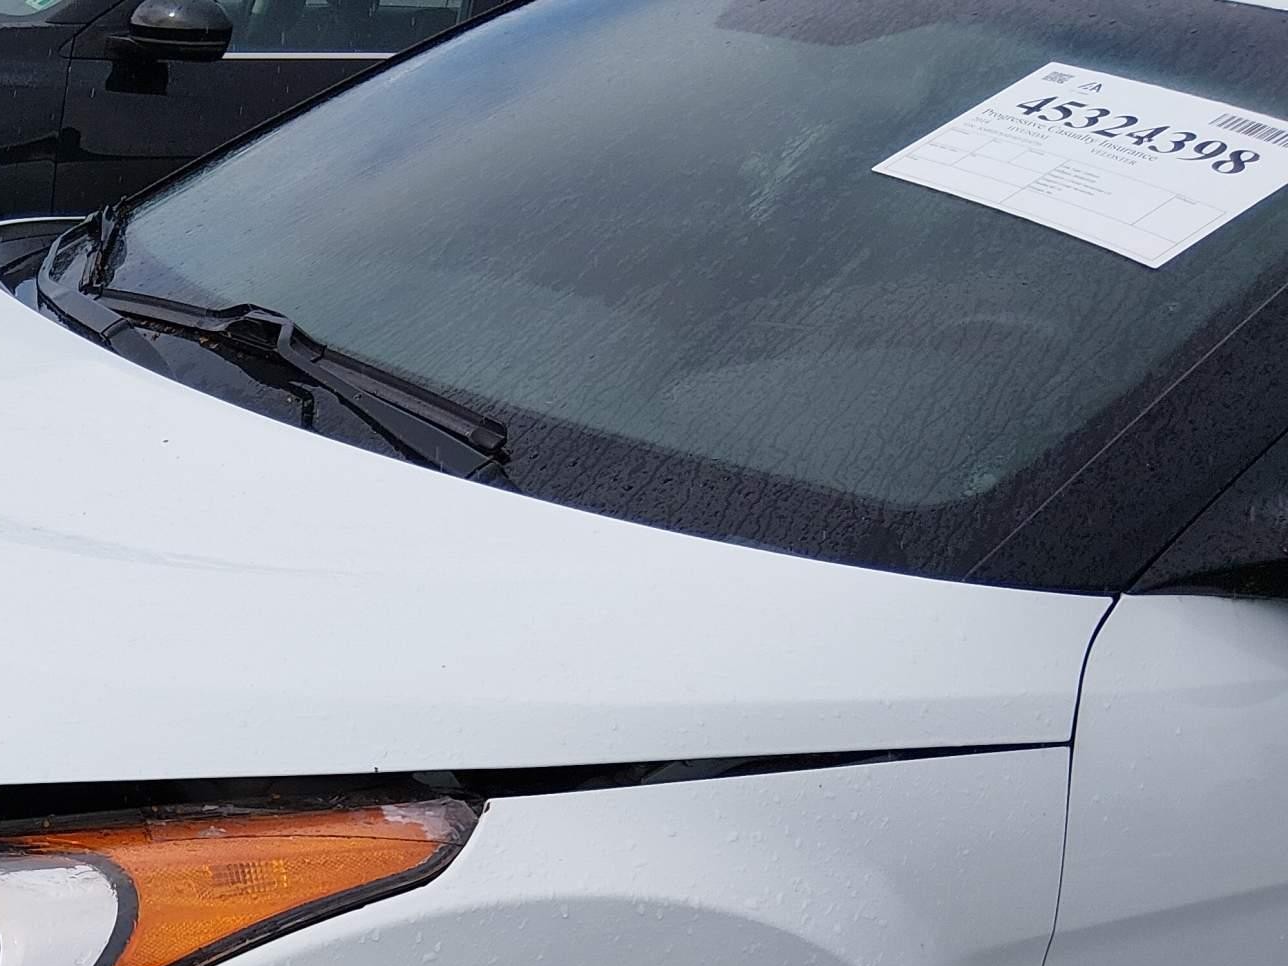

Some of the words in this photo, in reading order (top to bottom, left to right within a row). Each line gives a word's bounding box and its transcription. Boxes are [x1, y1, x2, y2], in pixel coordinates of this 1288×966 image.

[982, 108, 1047, 130] Progressive
[1048, 125, 1095, 145] Casualty
[1098, 140, 1158, 161] Insurance
[1015, 95, 1261, 174] 45324398
